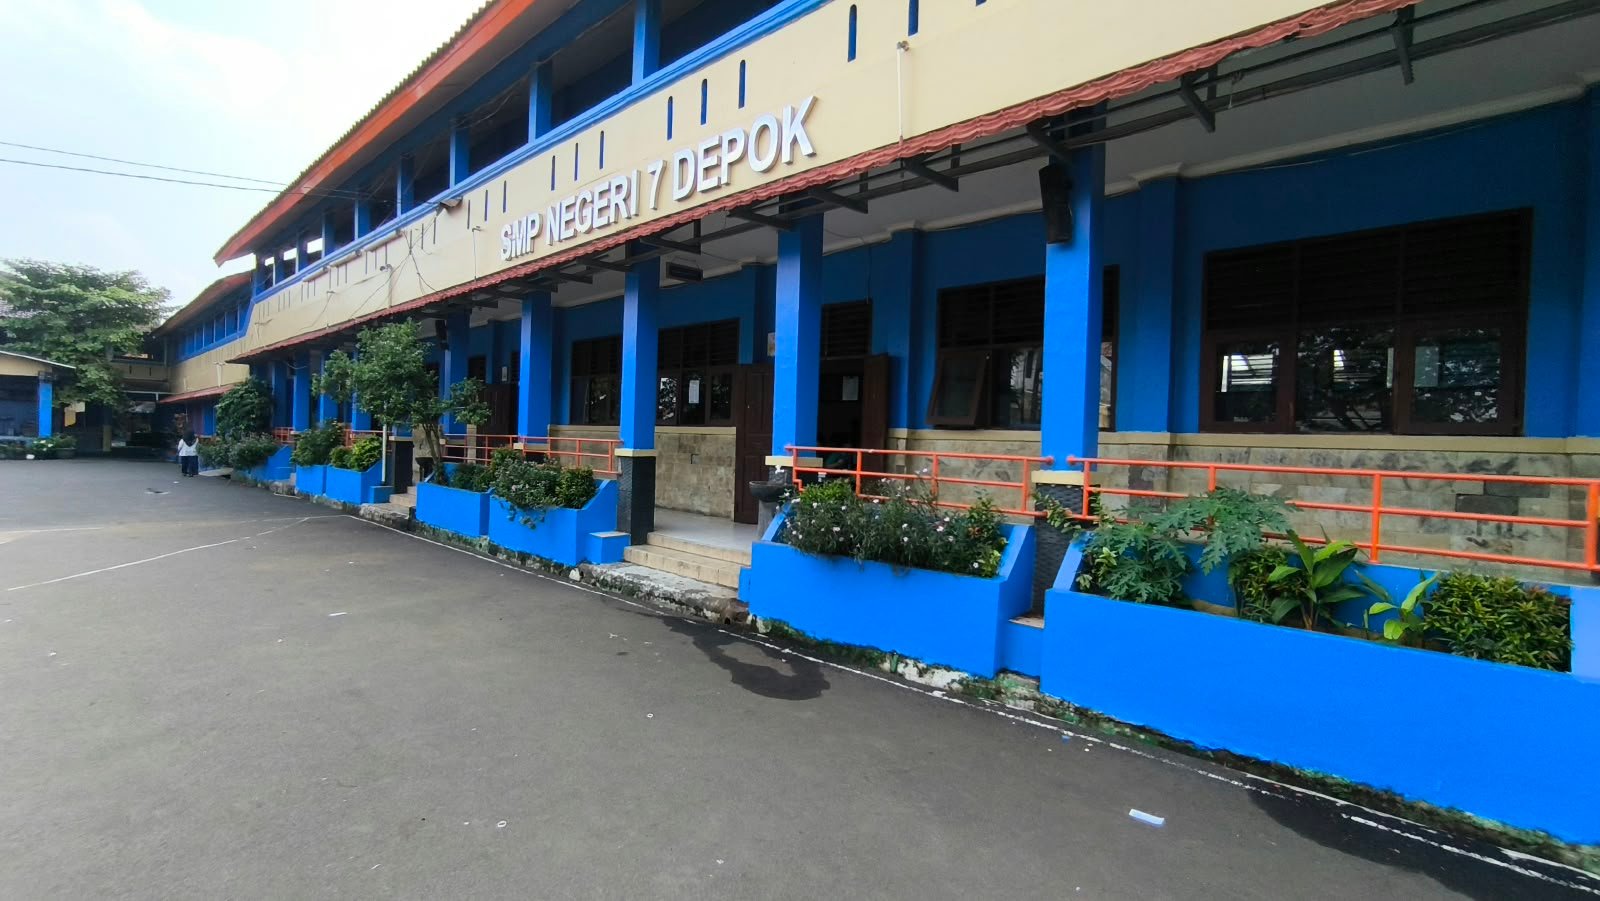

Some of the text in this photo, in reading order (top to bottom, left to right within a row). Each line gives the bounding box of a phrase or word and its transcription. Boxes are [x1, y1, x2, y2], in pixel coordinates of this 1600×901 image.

[500, 96, 817, 261] SMP NEGERI 7 DEPOK
